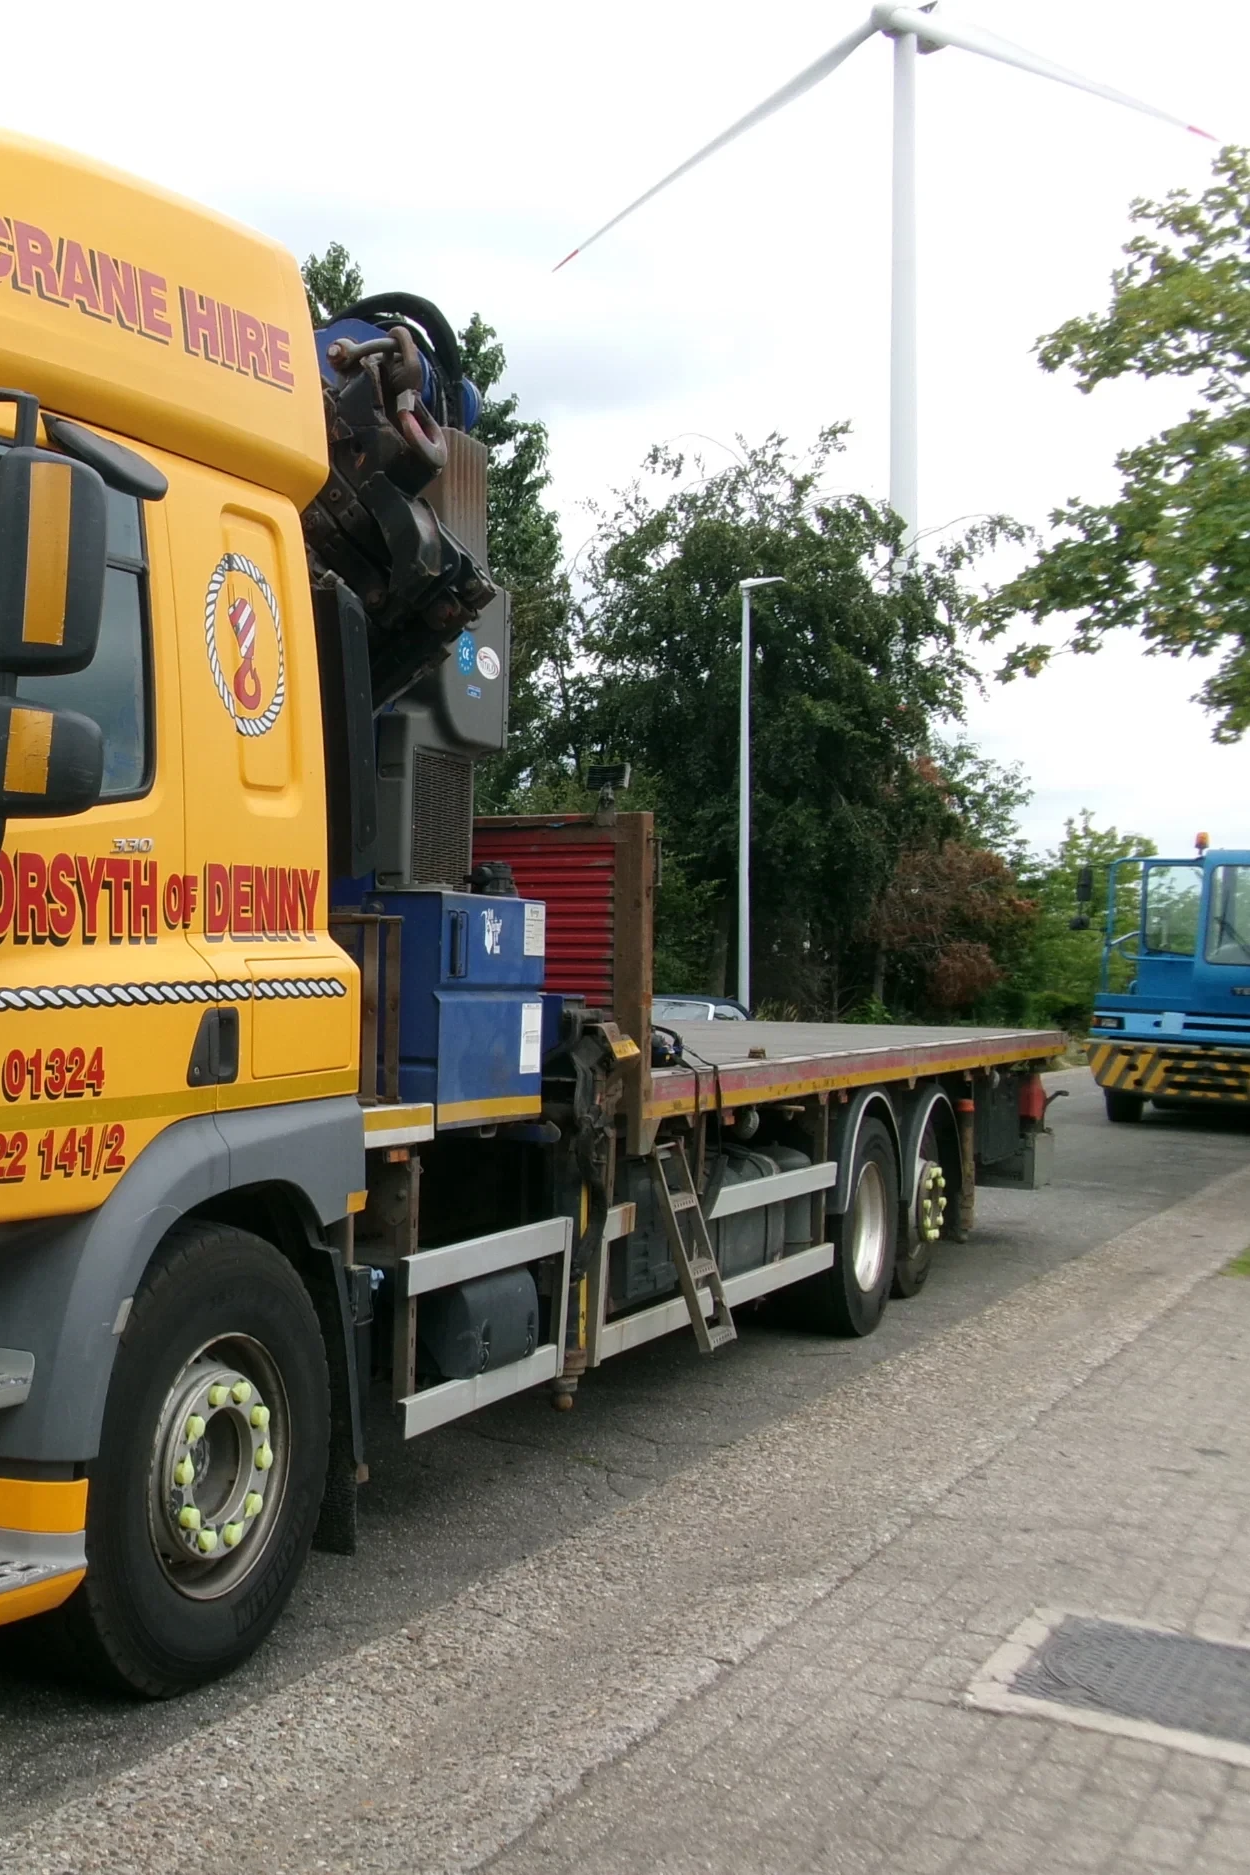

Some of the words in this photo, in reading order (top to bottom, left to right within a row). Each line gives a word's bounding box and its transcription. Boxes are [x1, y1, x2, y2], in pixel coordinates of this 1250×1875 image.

[178, 285, 295, 394] HIRE
[110, 837, 154, 854] 330
[163, 873, 198, 930] OF
[203, 860, 321, 943] DENNY
[2, 1046, 106, 1101] 01324
[38, 1124, 126, 1179] 141/2
